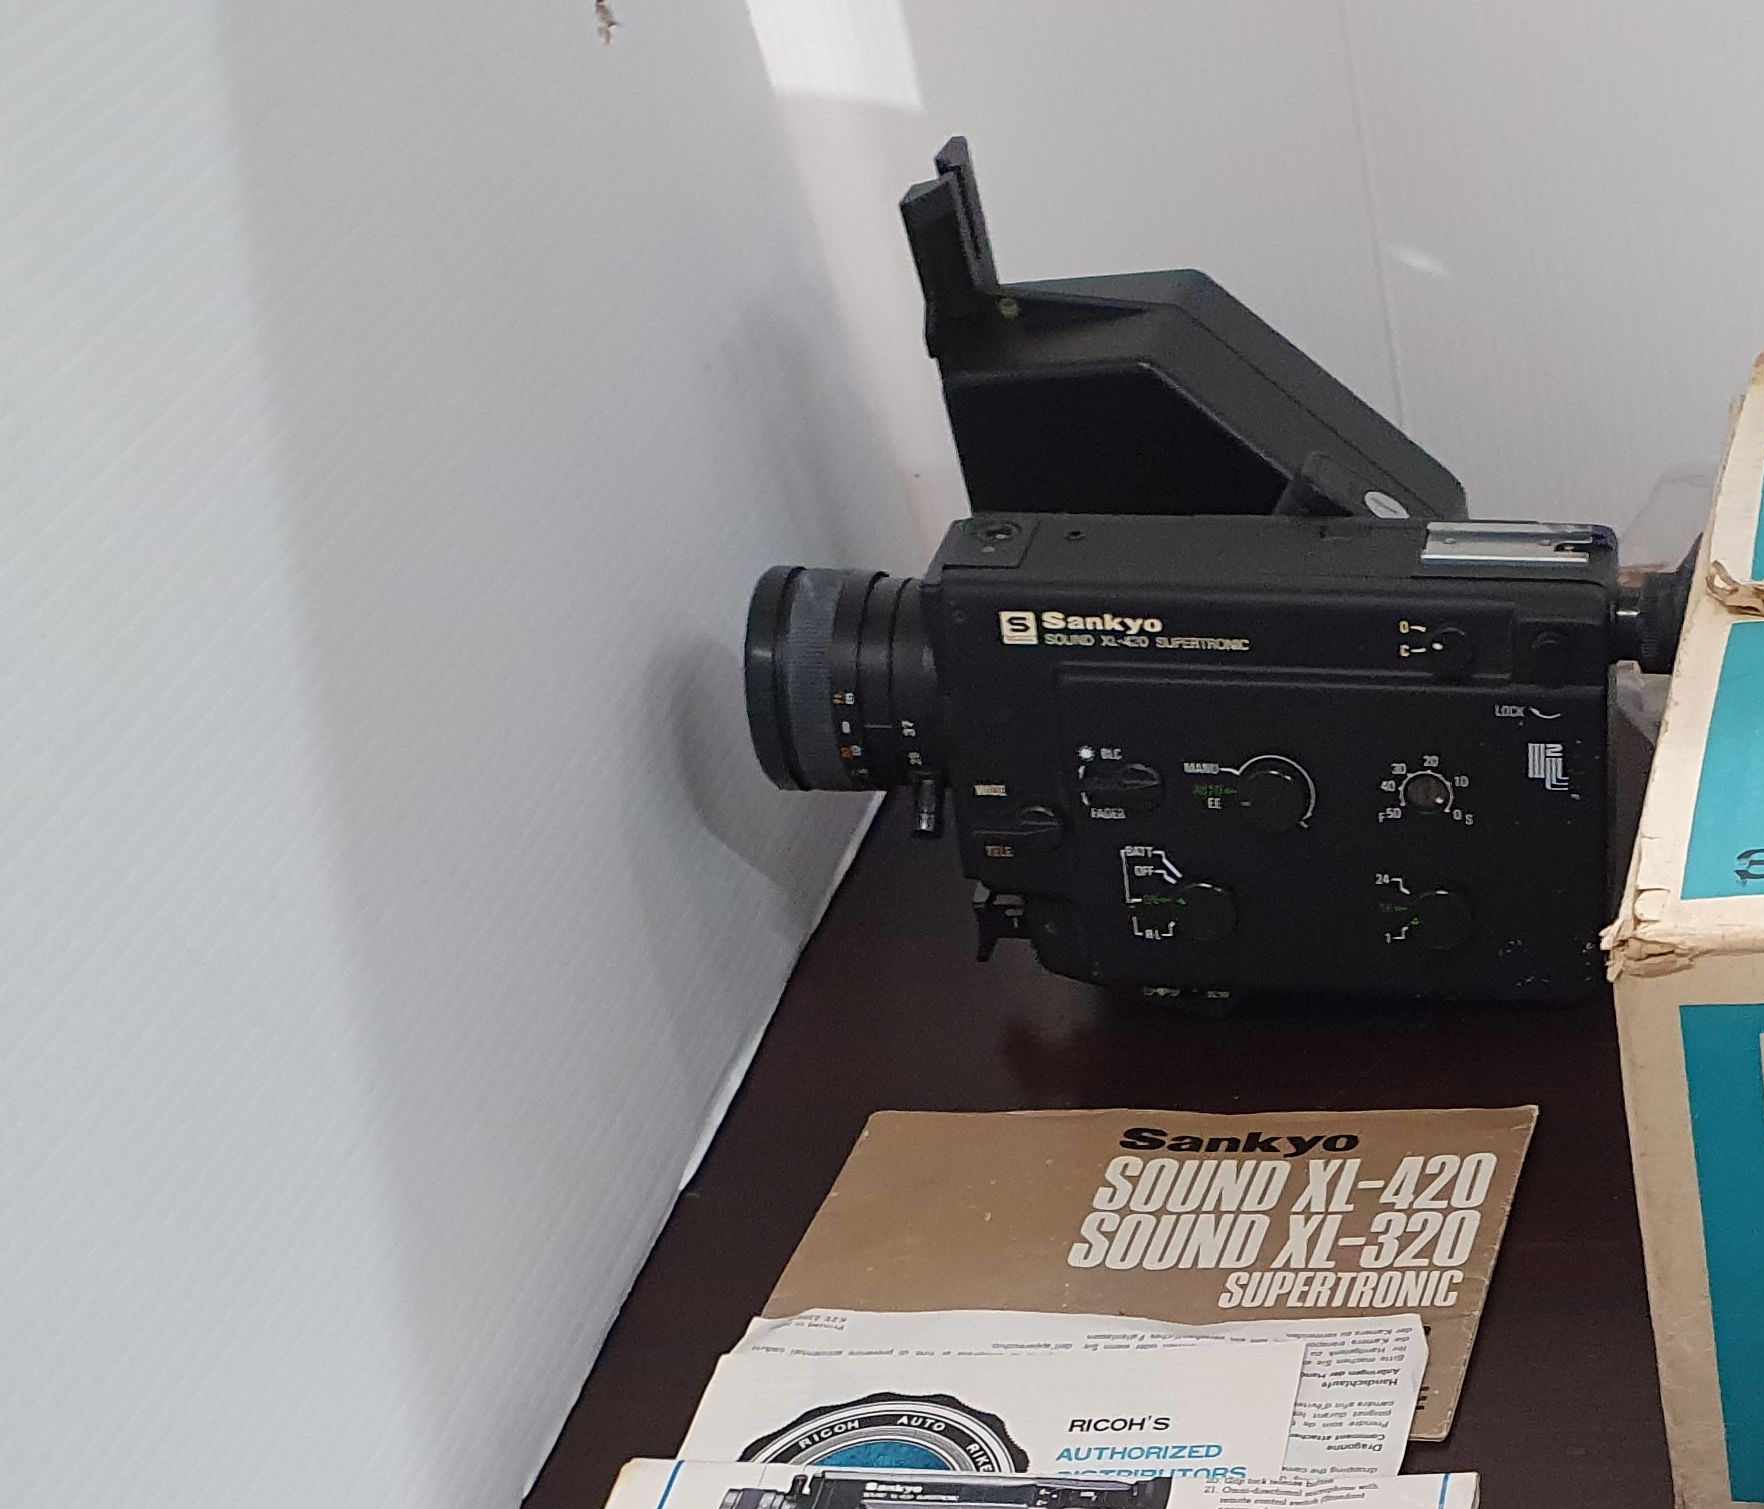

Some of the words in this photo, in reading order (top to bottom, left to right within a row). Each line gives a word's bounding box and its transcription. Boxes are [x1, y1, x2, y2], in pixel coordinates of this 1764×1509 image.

[1041, 612, 1163, 635] Sankyo
[1045, 634, 1095, 647] SOUND
[1155, 637, 1250, 651] SUPERTRONIC
[1494, 706, 1526, 718] LOCK
[1391, 763, 1408, 775] 30
[1423, 755, 1440, 768] 20
[1453, 776, 1470, 788] 10
[1118, 1127, 1360, 1157] Sankyo
[1092, 1156, 1293, 1213] SOUND
[1291, 1152, 1498, 1213] XL-420
[1067, 1212, 1271, 1271] SOUND
[1269, 1210, 1483, 1269] XL-320
[1217, 1270, 1465, 1309] SUPERTRONIC
[798, 1419, 862, 1450] RICOH
[896, 1415, 948, 1432] AUTO
[1068, 1417, 1171, 1434] RICOH'S
[1055, 1444, 1222, 1463] AUTHORIZED
